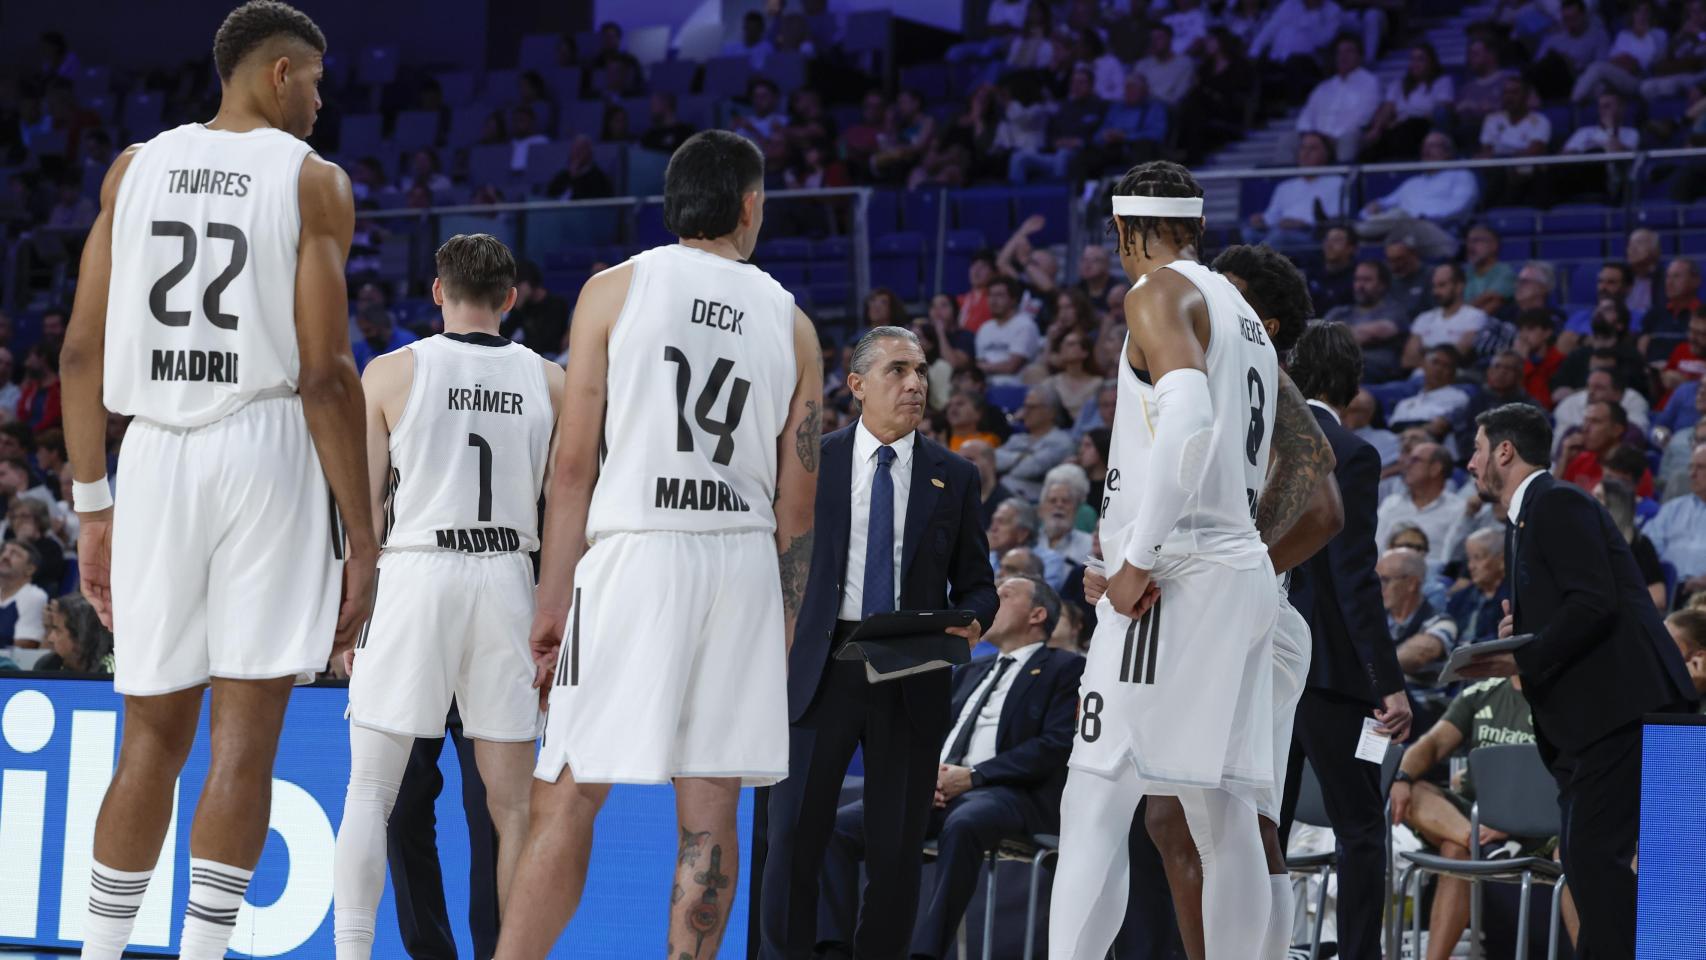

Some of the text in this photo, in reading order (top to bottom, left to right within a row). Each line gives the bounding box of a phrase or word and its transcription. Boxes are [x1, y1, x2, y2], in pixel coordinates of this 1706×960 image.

[168, 168, 252, 198] TAVARES
[149, 220, 248, 331] 22
[691, 298, 744, 335] DECK
[448, 383, 524, 416] KRÄMER
[664, 345, 752, 467] 14
[468, 432, 493, 522] 1
[435, 526, 520, 553] MADRID
